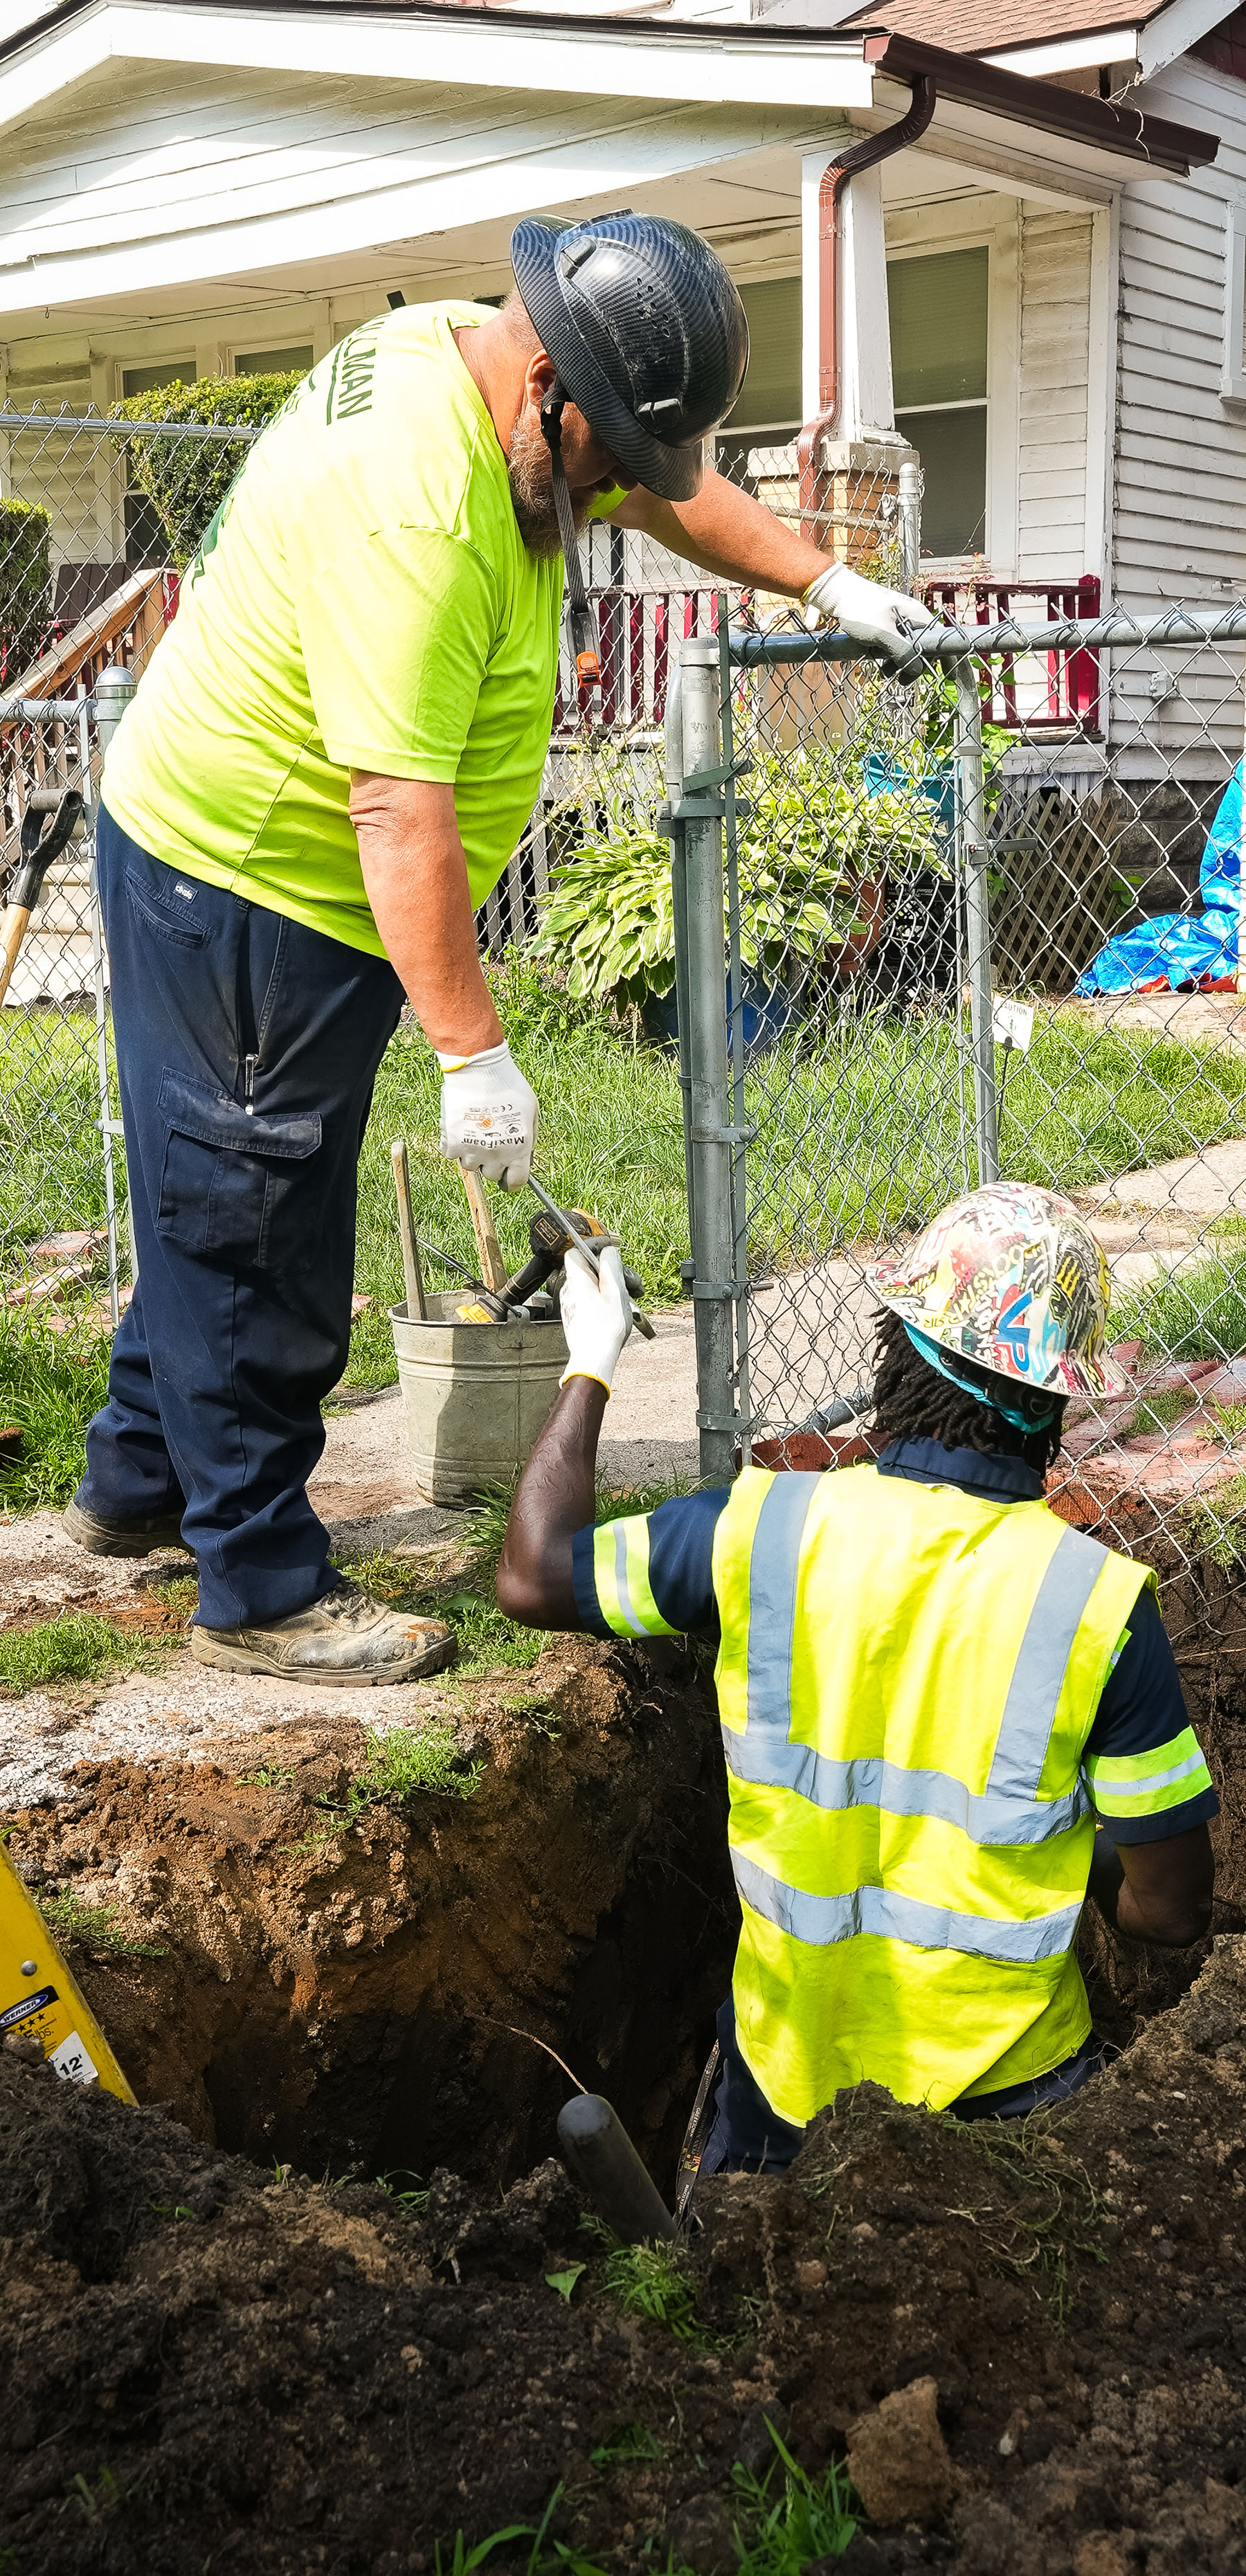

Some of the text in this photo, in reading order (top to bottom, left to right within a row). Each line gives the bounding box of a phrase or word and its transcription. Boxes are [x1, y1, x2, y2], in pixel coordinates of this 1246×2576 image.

[878, 1272, 936, 1296] HINSO
[3, 2000, 37, 2022] WERNER
[60, 2053, 83, 2075] 12'
